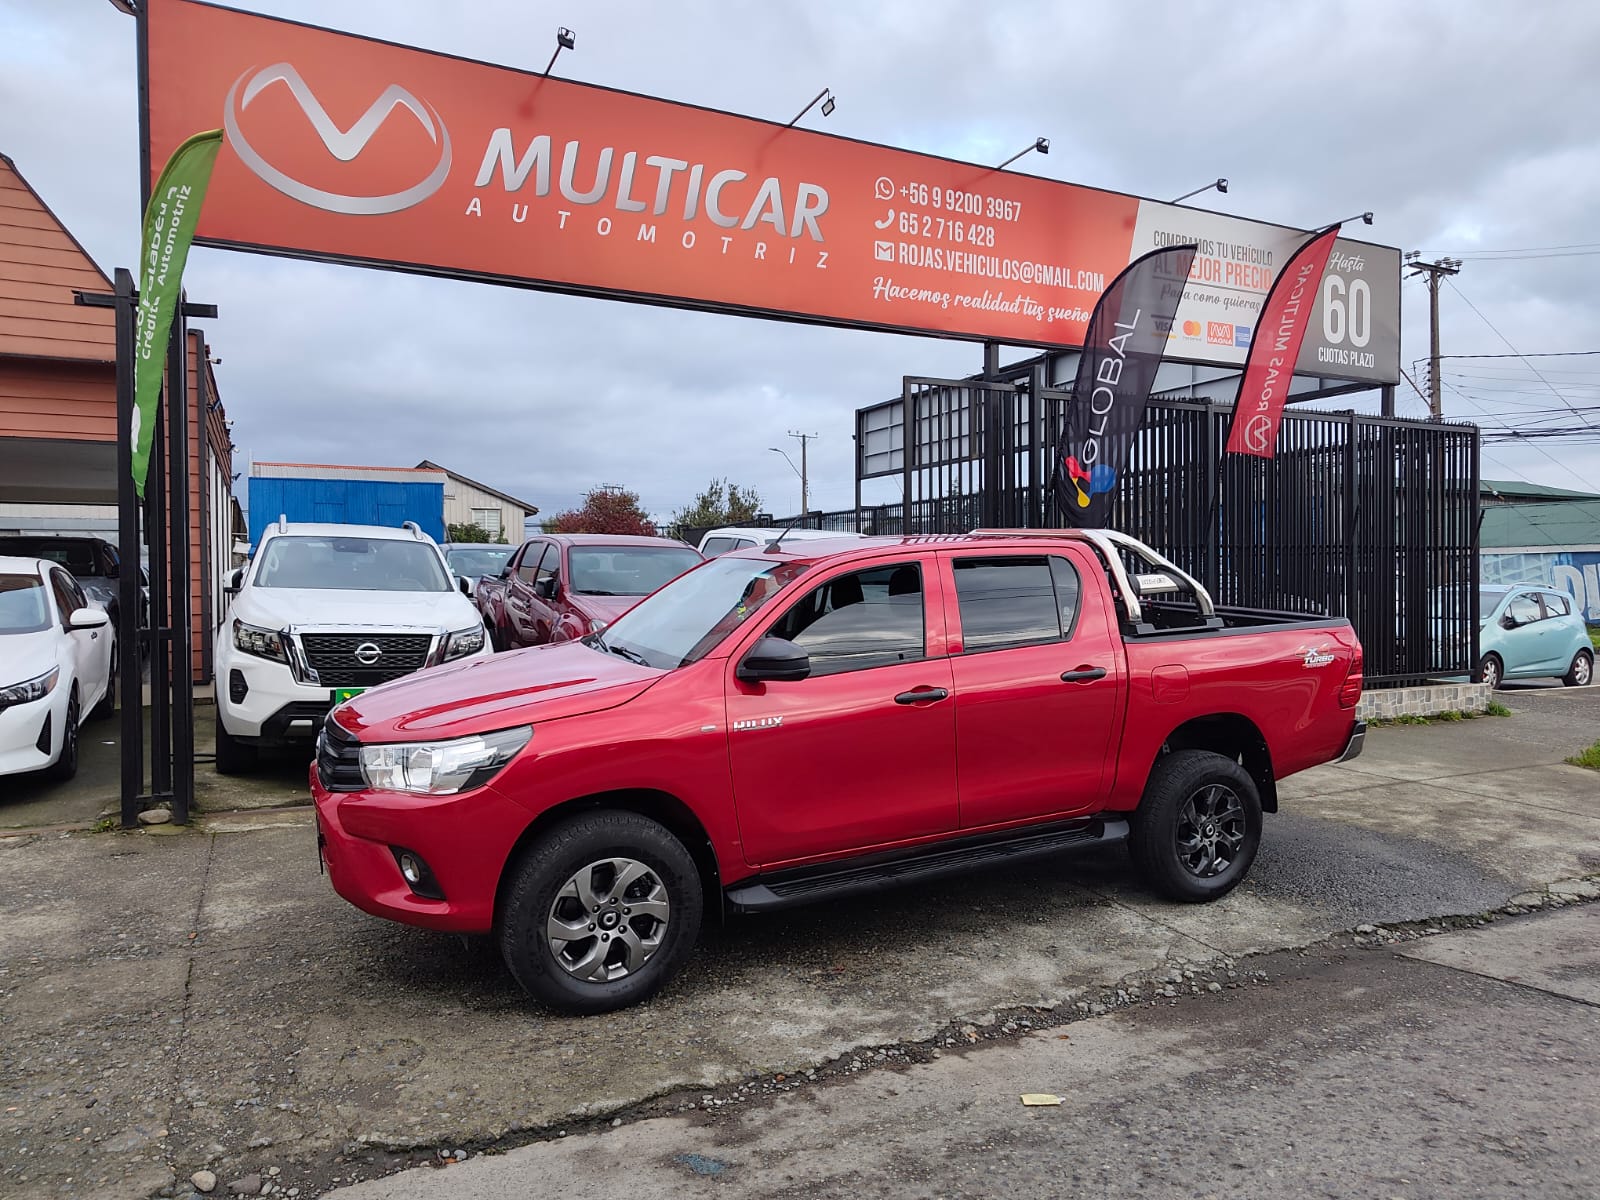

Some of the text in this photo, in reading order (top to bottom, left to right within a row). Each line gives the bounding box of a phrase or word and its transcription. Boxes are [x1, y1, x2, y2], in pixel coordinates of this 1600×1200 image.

[474, 128, 829, 242] MULTICAR
[899, 182, 1022, 222] +56 9 9200 3967
[157, 185, 192, 286] Automotriz
[465, 197, 829, 269] AUTOMOTRIZ
[899, 211, 995, 247] 65 2 716 428
[899, 242, 1105, 293] ROJAS.VEHICULOS@GMAIL.COM
[1175, 255, 1221, 283] MEJOR
[1225, 261, 1273, 291] PRECIO
[1216, 242, 1228, 258] TU
[1230, 244, 1273, 266] VEHÍCULO
[1330, 252, 1366, 272] Hasta
[872, 276, 1092, 323] Hacemos realidad tus sueño
[1193, 291, 1221, 305] como
[1323, 274, 1371, 347] 60
[1318, 347, 1375, 368] CUOTAS PLAZO
[1082, 309, 1141, 464] GLOBAL
[1303, 654, 1335, 665] TURBO
